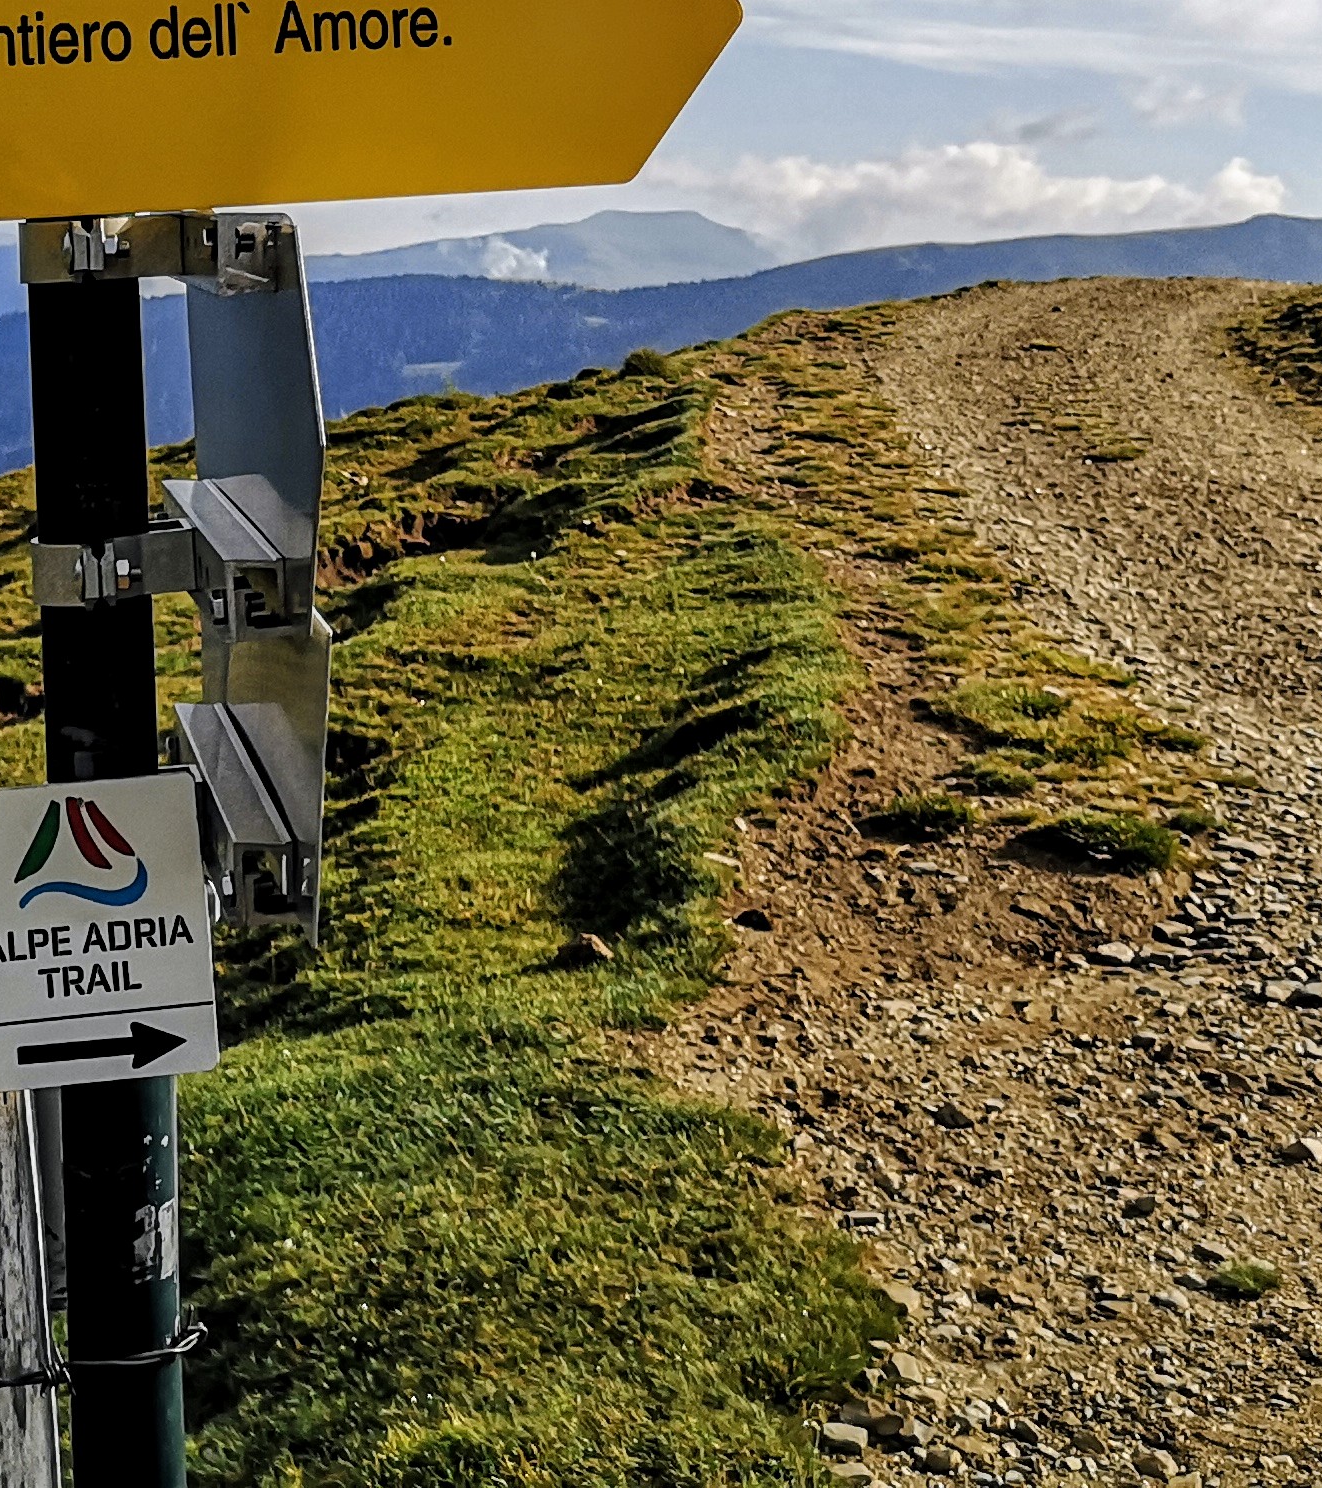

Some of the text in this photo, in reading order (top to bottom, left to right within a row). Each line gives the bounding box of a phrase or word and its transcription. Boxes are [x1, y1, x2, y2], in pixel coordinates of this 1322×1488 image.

[275, 0, 452, 53] Amore.
[83, 915, 193, 953] ADRIA
[38, 961, 142, 998] TRAIL
